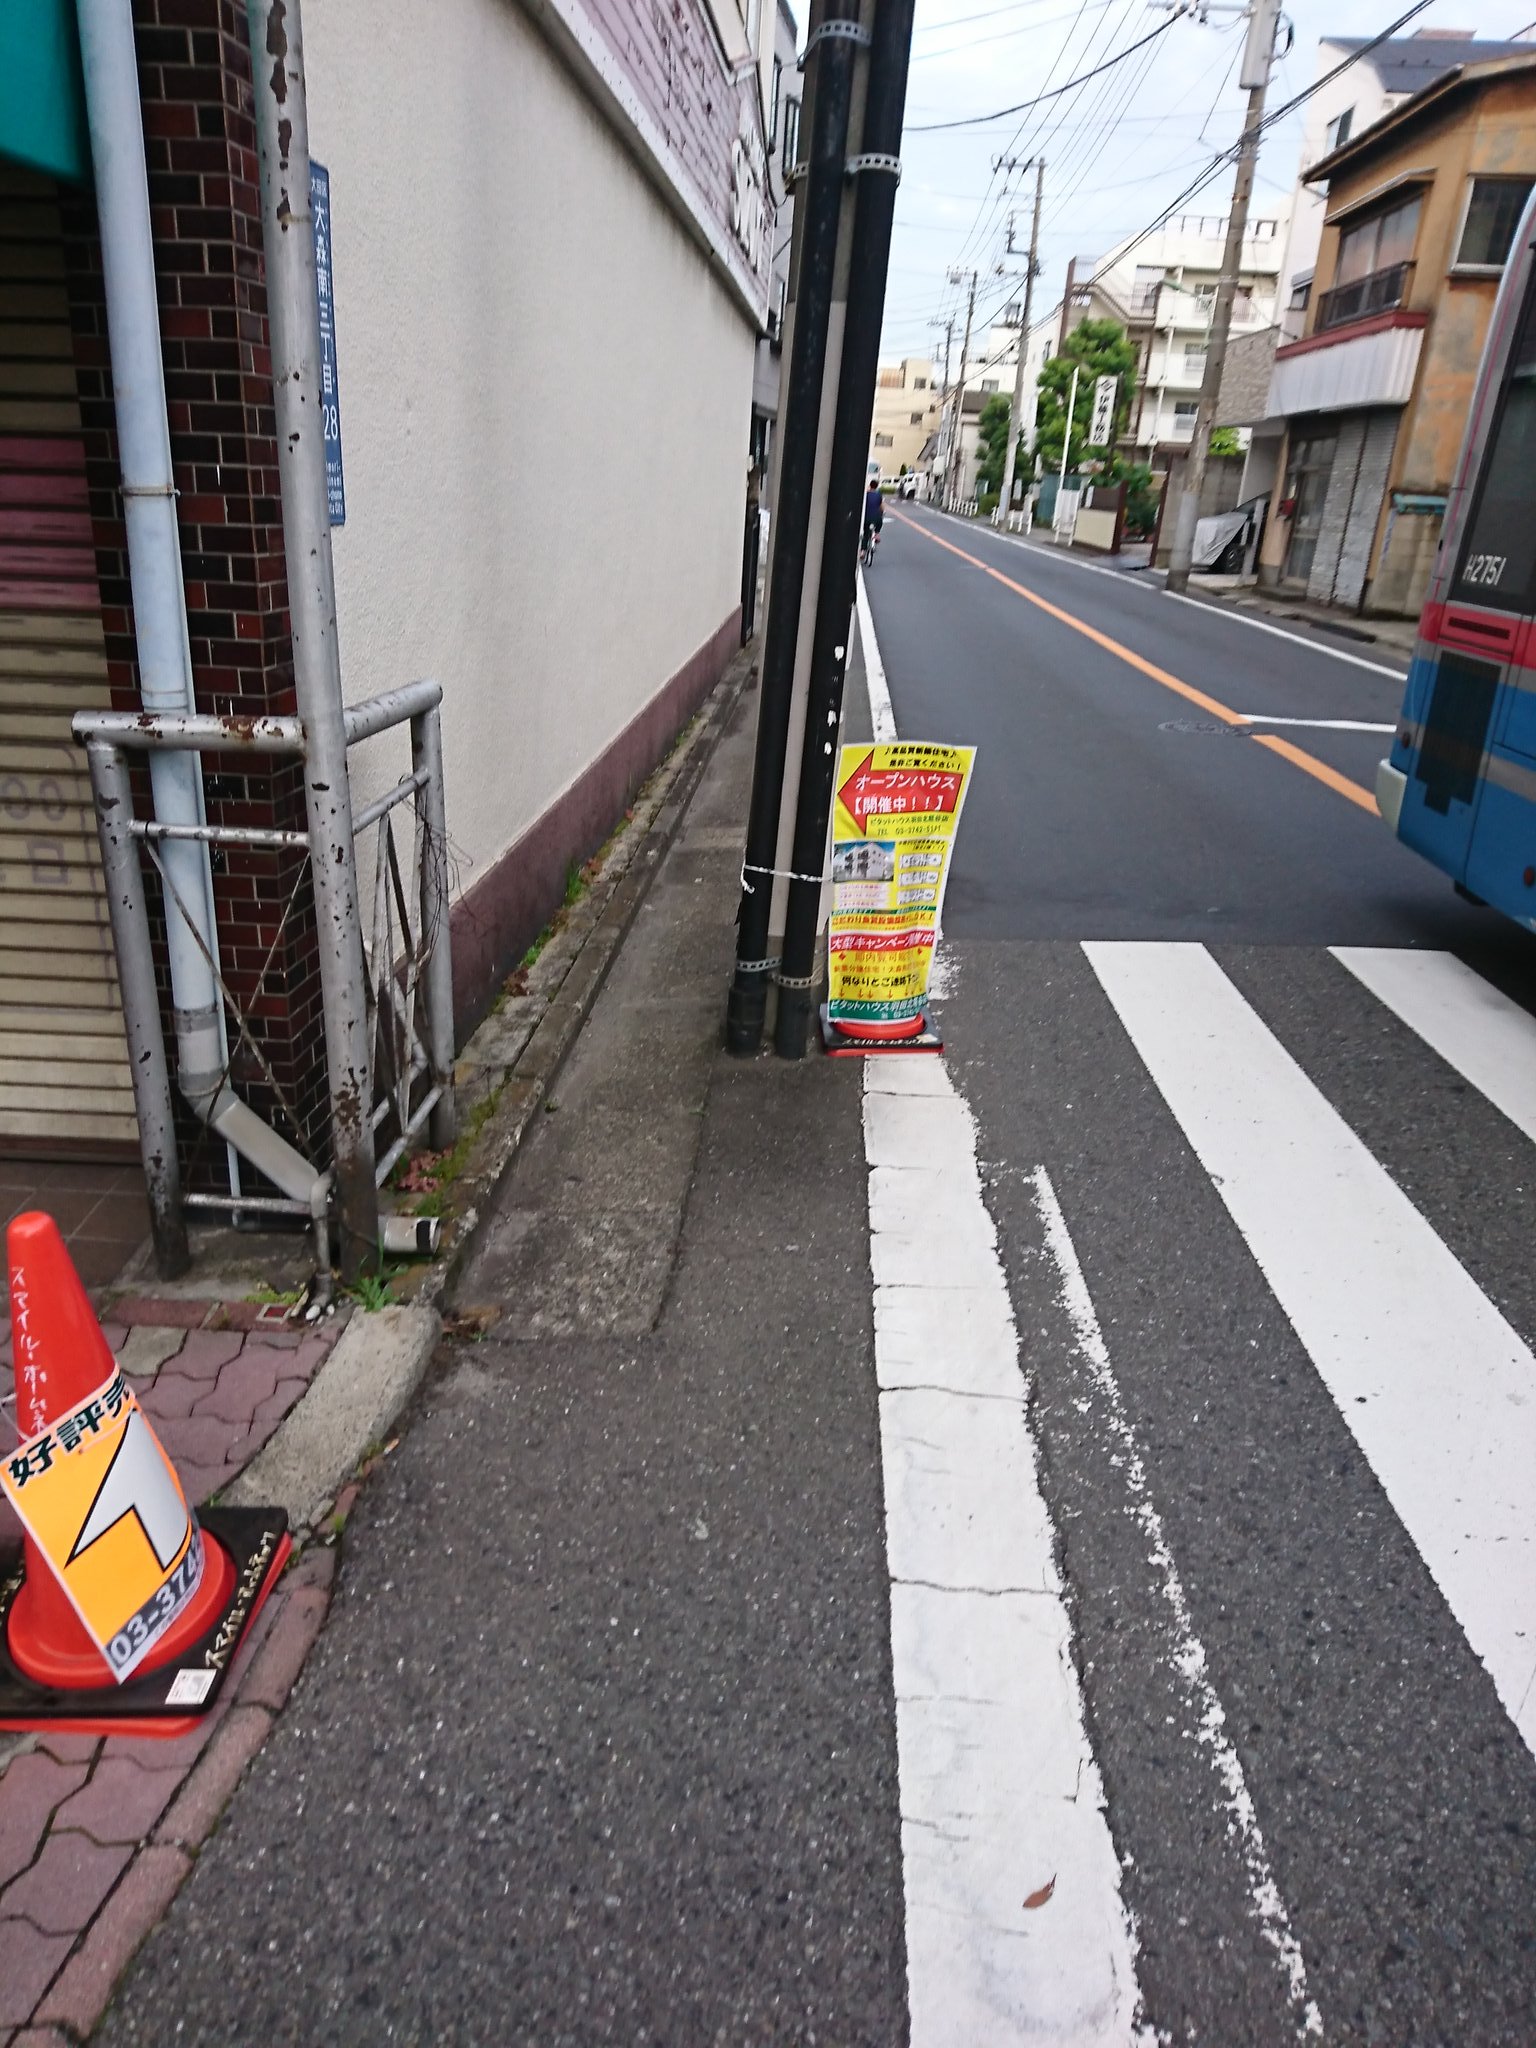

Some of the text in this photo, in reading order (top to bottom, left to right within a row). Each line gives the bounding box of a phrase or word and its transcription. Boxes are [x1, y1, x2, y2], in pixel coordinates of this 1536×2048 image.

[314, 200, 333, 394] 大森南三丁目
[323, 404, 338, 440] 28
[1462, 553, 1507, 586] H2751
[855, 771, 955, 792] オープンハウス
